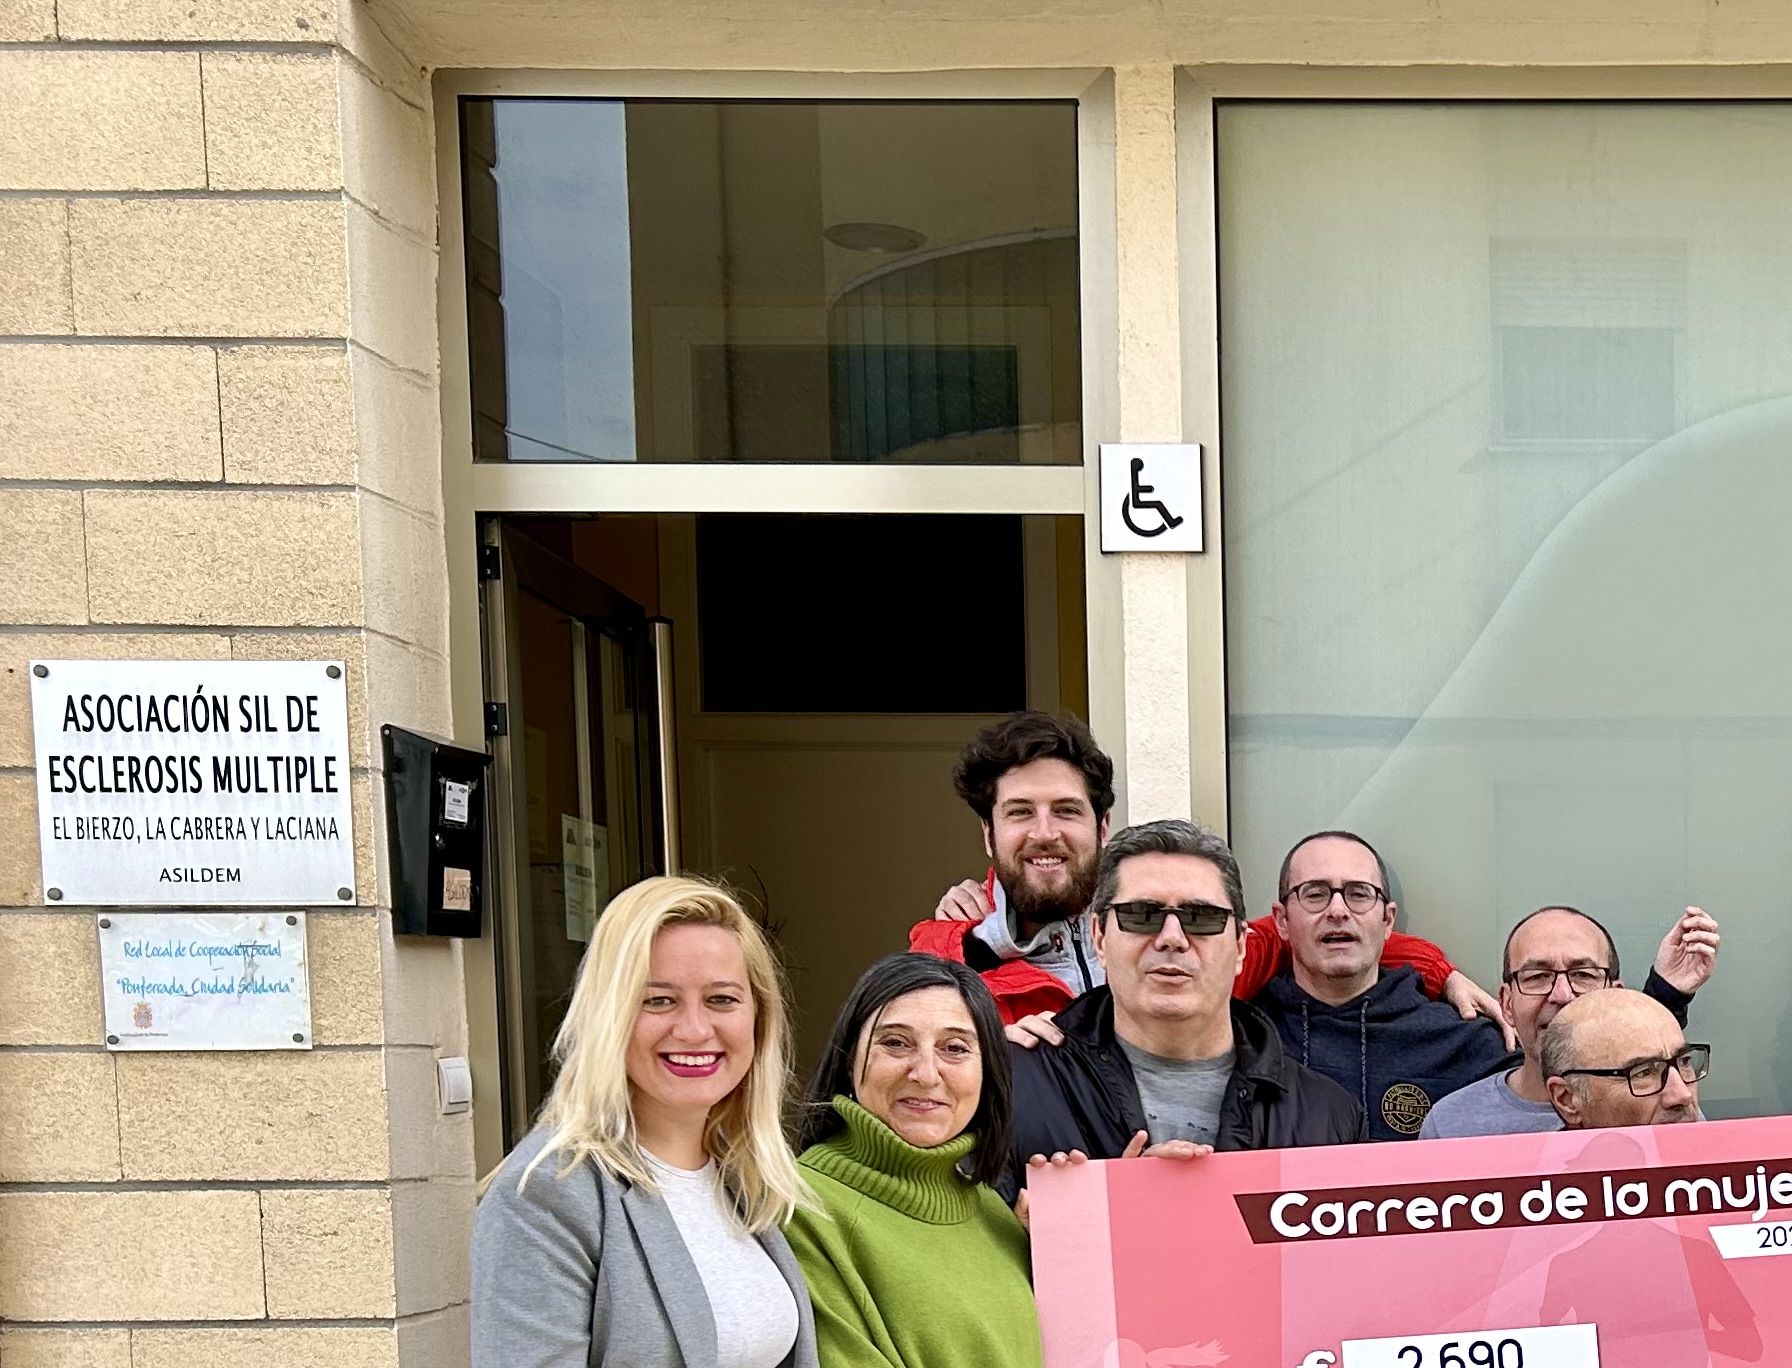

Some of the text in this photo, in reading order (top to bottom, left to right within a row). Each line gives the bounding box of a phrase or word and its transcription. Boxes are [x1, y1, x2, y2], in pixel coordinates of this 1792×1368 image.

[63, 684, 320, 732] ASOCIACIÓN SIL DE
[48, 755, 338, 793] ESCLEROSIS MULTIPLE
[53, 816, 340, 844] EL BIERZO, LA CABRERA Y LACIANA
[159, 866, 241, 883] ASILDEM
[123, 939, 143, 958] Red
[145, 939, 173, 958] Local
[174, 939, 187, 958] de
[1269, 1191, 1505, 1239] Carrera
[1519, 1179, 1589, 1223] de
[1602, 1175, 1649, 1217] la
